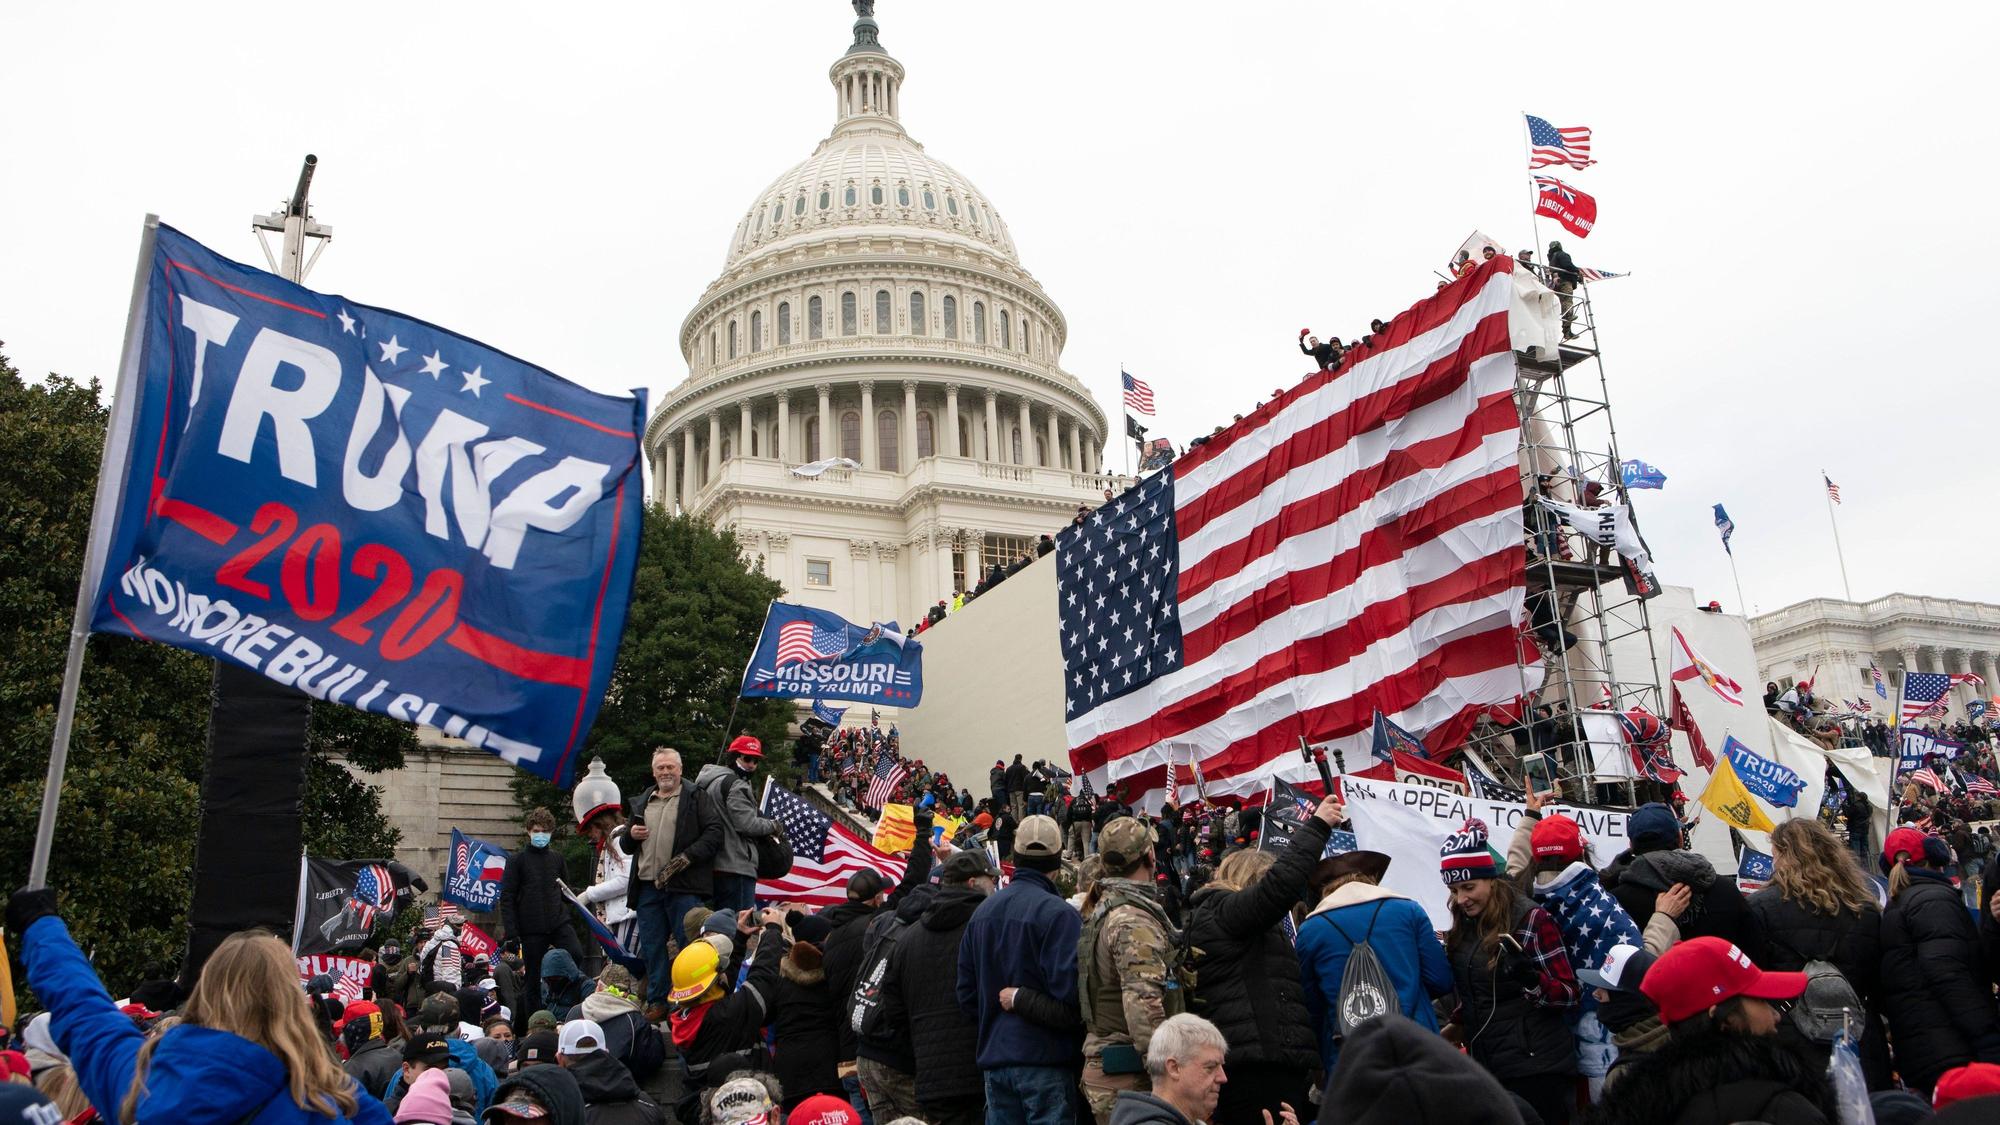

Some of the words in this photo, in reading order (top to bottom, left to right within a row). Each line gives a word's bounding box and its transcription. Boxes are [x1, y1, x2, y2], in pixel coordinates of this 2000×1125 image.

[178, 293, 612, 570] TRUMP
[214, 502, 464, 661] 2020
[121, 555, 176, 615] NO
[168, 580, 295, 669] MORE
[776, 661, 895, 684] MISSOURI
[777, 681, 811, 695] FOR
[817, 682, 883, 696] TRUMP
[1734, 748, 1801, 787] TRUMP
[1343, 780, 1376, 800] AN
[1489, 806, 1524, 829] TO
[1440, 825, 1487, 852] RUMP
[455, 874, 497, 898] TEAS
[716, 1091, 757, 1111] TRUMP
